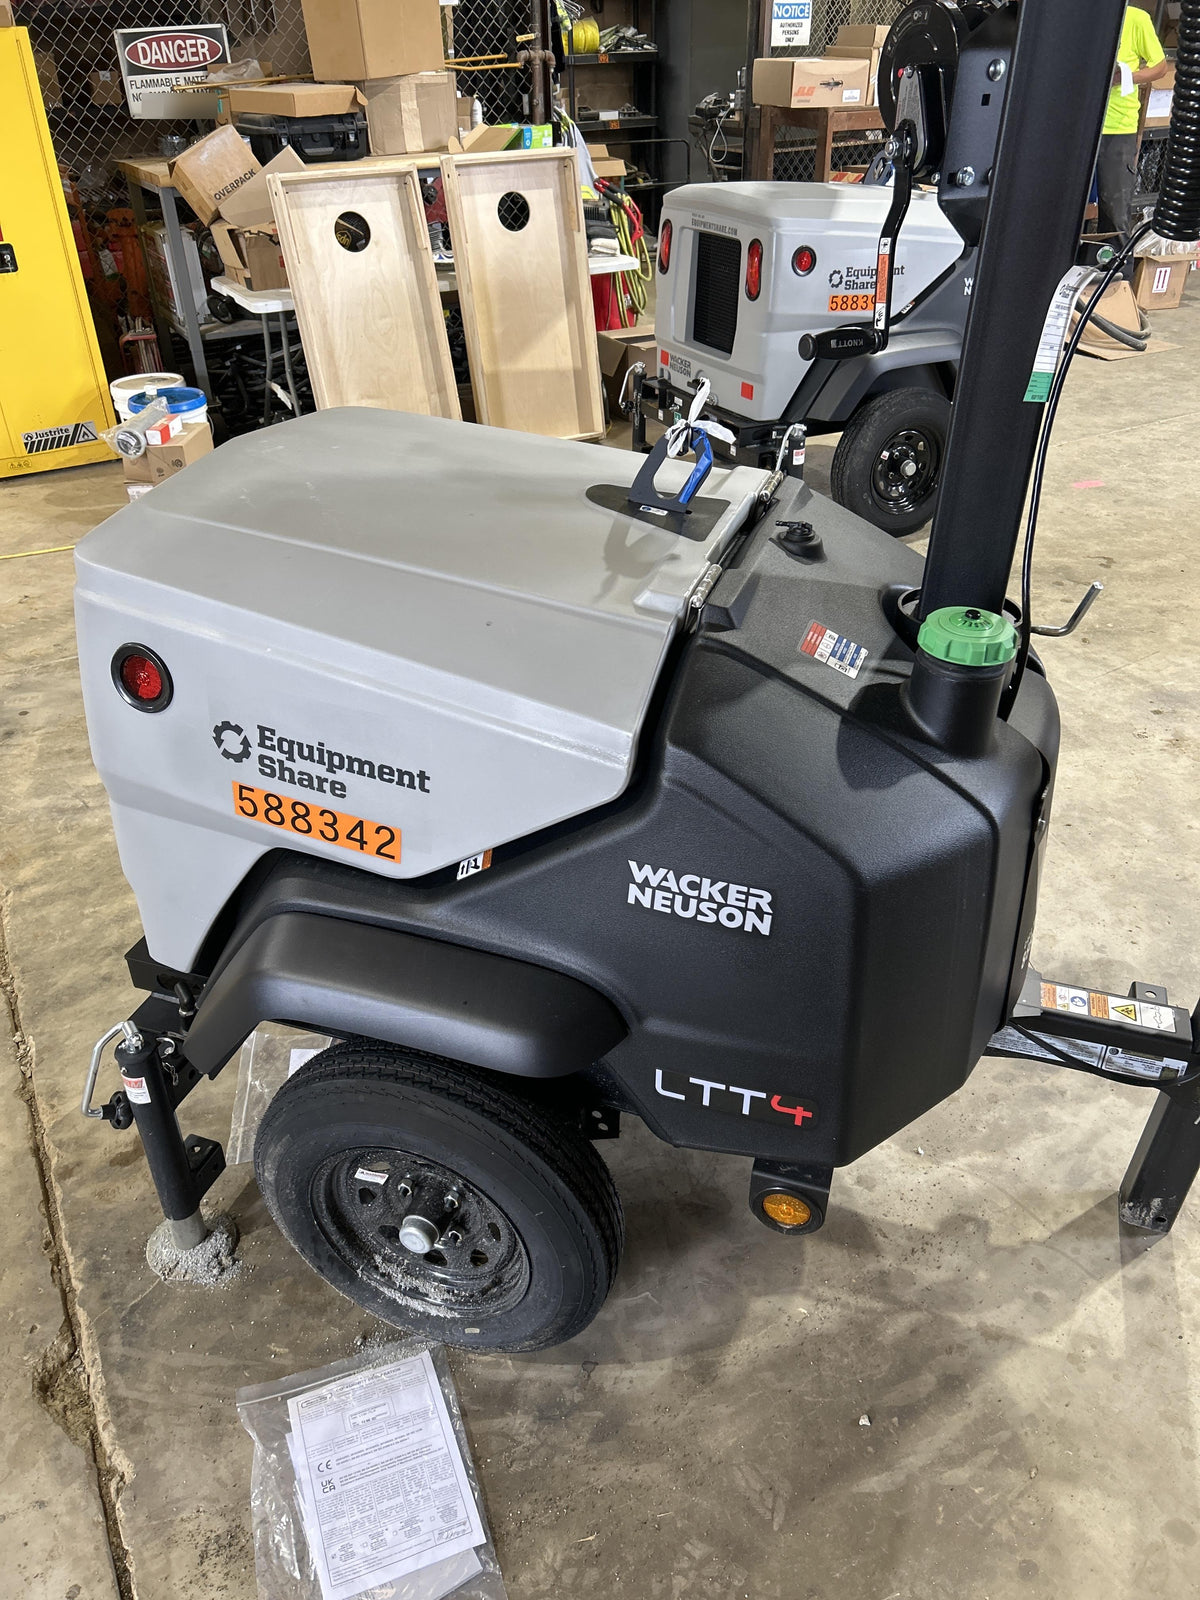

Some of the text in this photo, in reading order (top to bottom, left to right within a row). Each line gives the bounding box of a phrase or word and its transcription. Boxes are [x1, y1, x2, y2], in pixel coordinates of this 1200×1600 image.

[774, 4, 810, 18] NOTICE
[136, 38, 211, 65] DANGER
[129, 77, 181, 90] FLAMMABLE
[213, 168, 257, 200] OVERPACK
[845, 264, 906, 280] Equipnt
[844, 279, 877, 290] Share
[836, 338, 864, 347] KNOTT
[669, 353, 692, 369] WACKER
[669, 362, 692, 378] NEUSON
[34, 428, 70, 440] Justrite
[256, 724, 431, 794] Equipment
[257, 753, 347, 799] Share
[237, 784, 396, 860] 588342
[627, 859, 774, 914] WACKER
[627, 882, 773, 936] NEUSON
[654, 1068, 813, 1127] LTT4
[317, 1459, 333, 1473] CE
[320, 1478, 334, 1488] UK
[322, 1484, 336, 1494] CA
